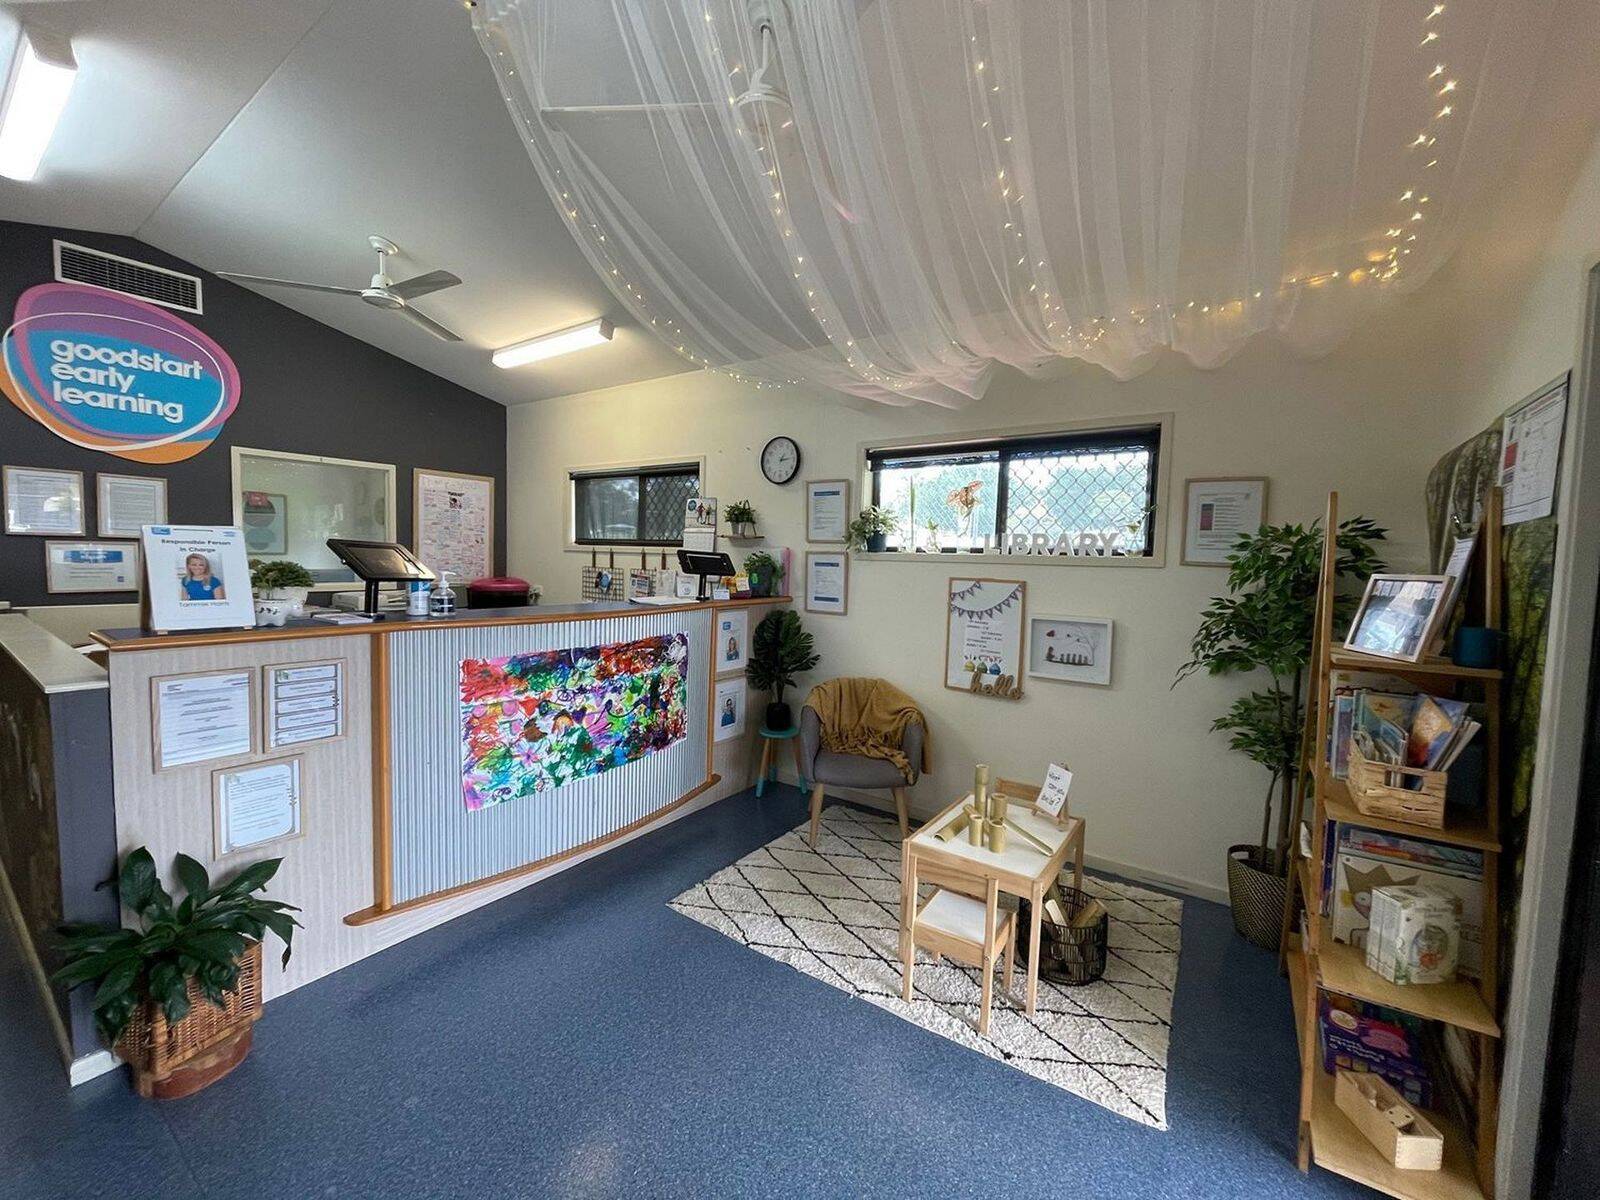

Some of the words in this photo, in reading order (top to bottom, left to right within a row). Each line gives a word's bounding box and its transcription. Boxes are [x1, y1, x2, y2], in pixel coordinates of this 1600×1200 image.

[51, 340, 203, 379] goodstart
[51, 363, 135, 393] early
[53, 381, 184, 423] learning
[984, 533, 1120, 557] LIBRARY
[970, 670, 1024, 700] hello
